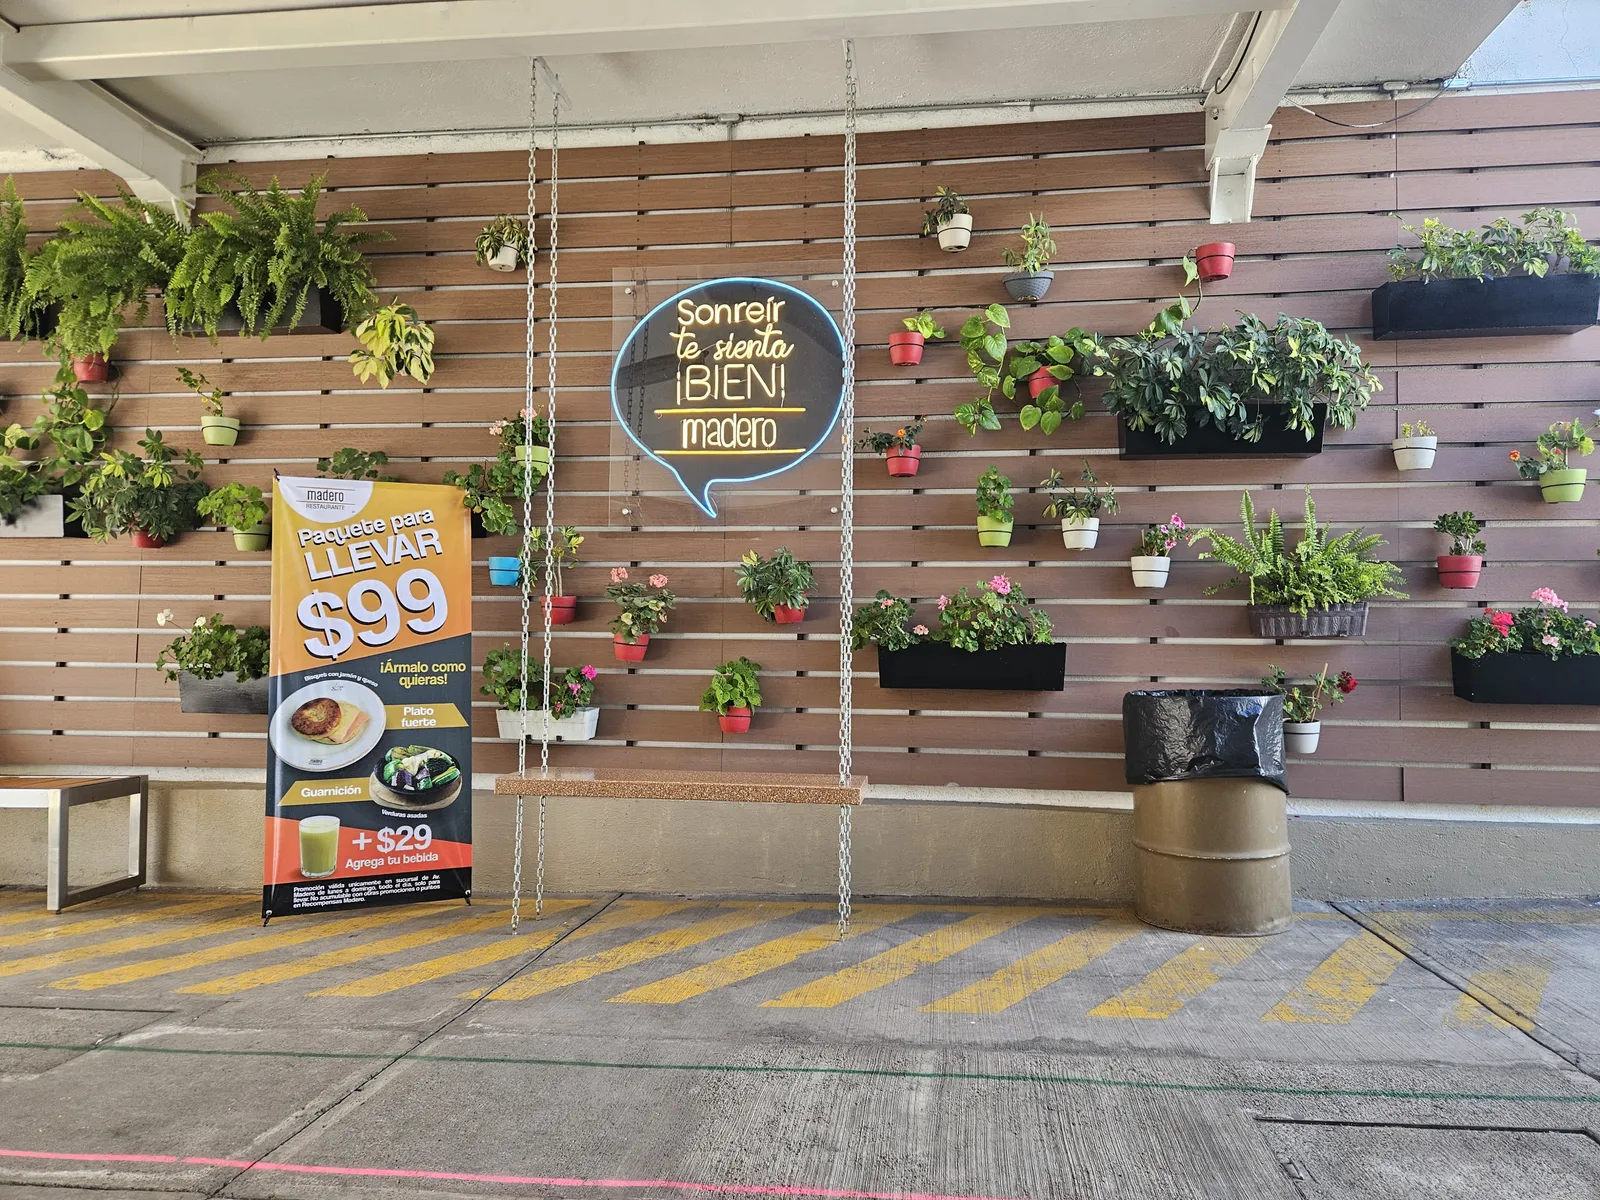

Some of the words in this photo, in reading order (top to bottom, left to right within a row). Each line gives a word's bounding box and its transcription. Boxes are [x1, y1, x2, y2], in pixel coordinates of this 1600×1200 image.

[677, 296, 786, 326] Sonreír
[669, 326, 703, 359] te
[713, 323, 795, 360] sienta
[676, 362, 786, 406] ¡BIEN!
[682, 412, 777, 449] madero
[307, 490, 345, 502] madero
[305, 503, 345, 511] RESTAURANTE
[297, 519, 387, 547] Paquete
[390, 509, 434, 534] para
[304, 528, 443, 582] LLEVAR
[297, 568, 448, 661] $99
[380, 659, 429, 673] ¡Ármalo
[431, 663, 467, 673] como
[362, 677, 379, 688] queso
[399, 674, 448, 689] quieras!
[403, 707, 434, 716] Plato
[401, 718, 437, 727] fuerte
[301, 785, 362, 798] Guarnición
[381, 809, 407, 818] Verduras
[377, 824, 432, 854] $29
[345, 856, 385, 870] Agrega
[387, 856, 401, 865] tu
[402, 852, 439, 864] bebida
[380, 886, 415, 896] promociones
